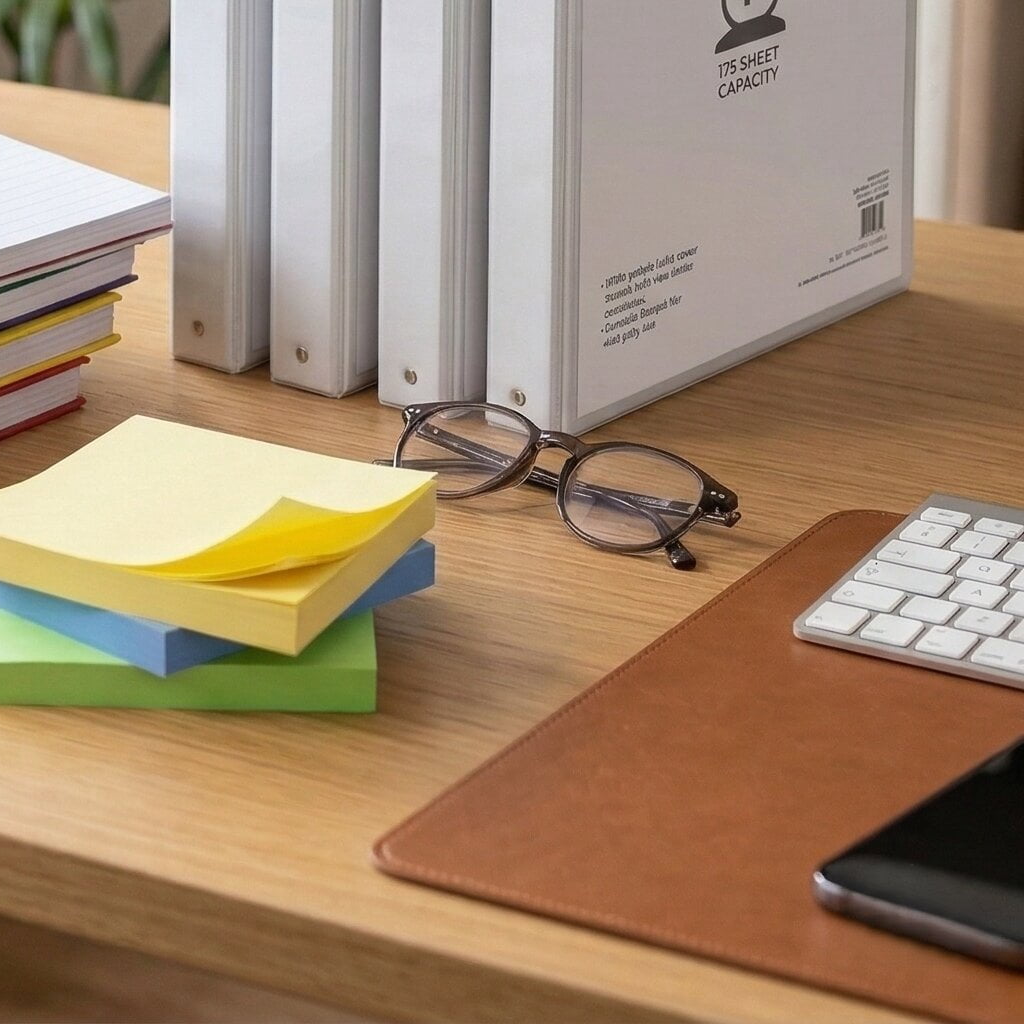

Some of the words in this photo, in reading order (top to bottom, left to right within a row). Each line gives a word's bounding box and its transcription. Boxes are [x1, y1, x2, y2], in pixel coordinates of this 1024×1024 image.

[718, 59, 737, 78] 175
[740, 45, 779, 71] SHEET
[718, 66, 779, 99] CAPACITY
